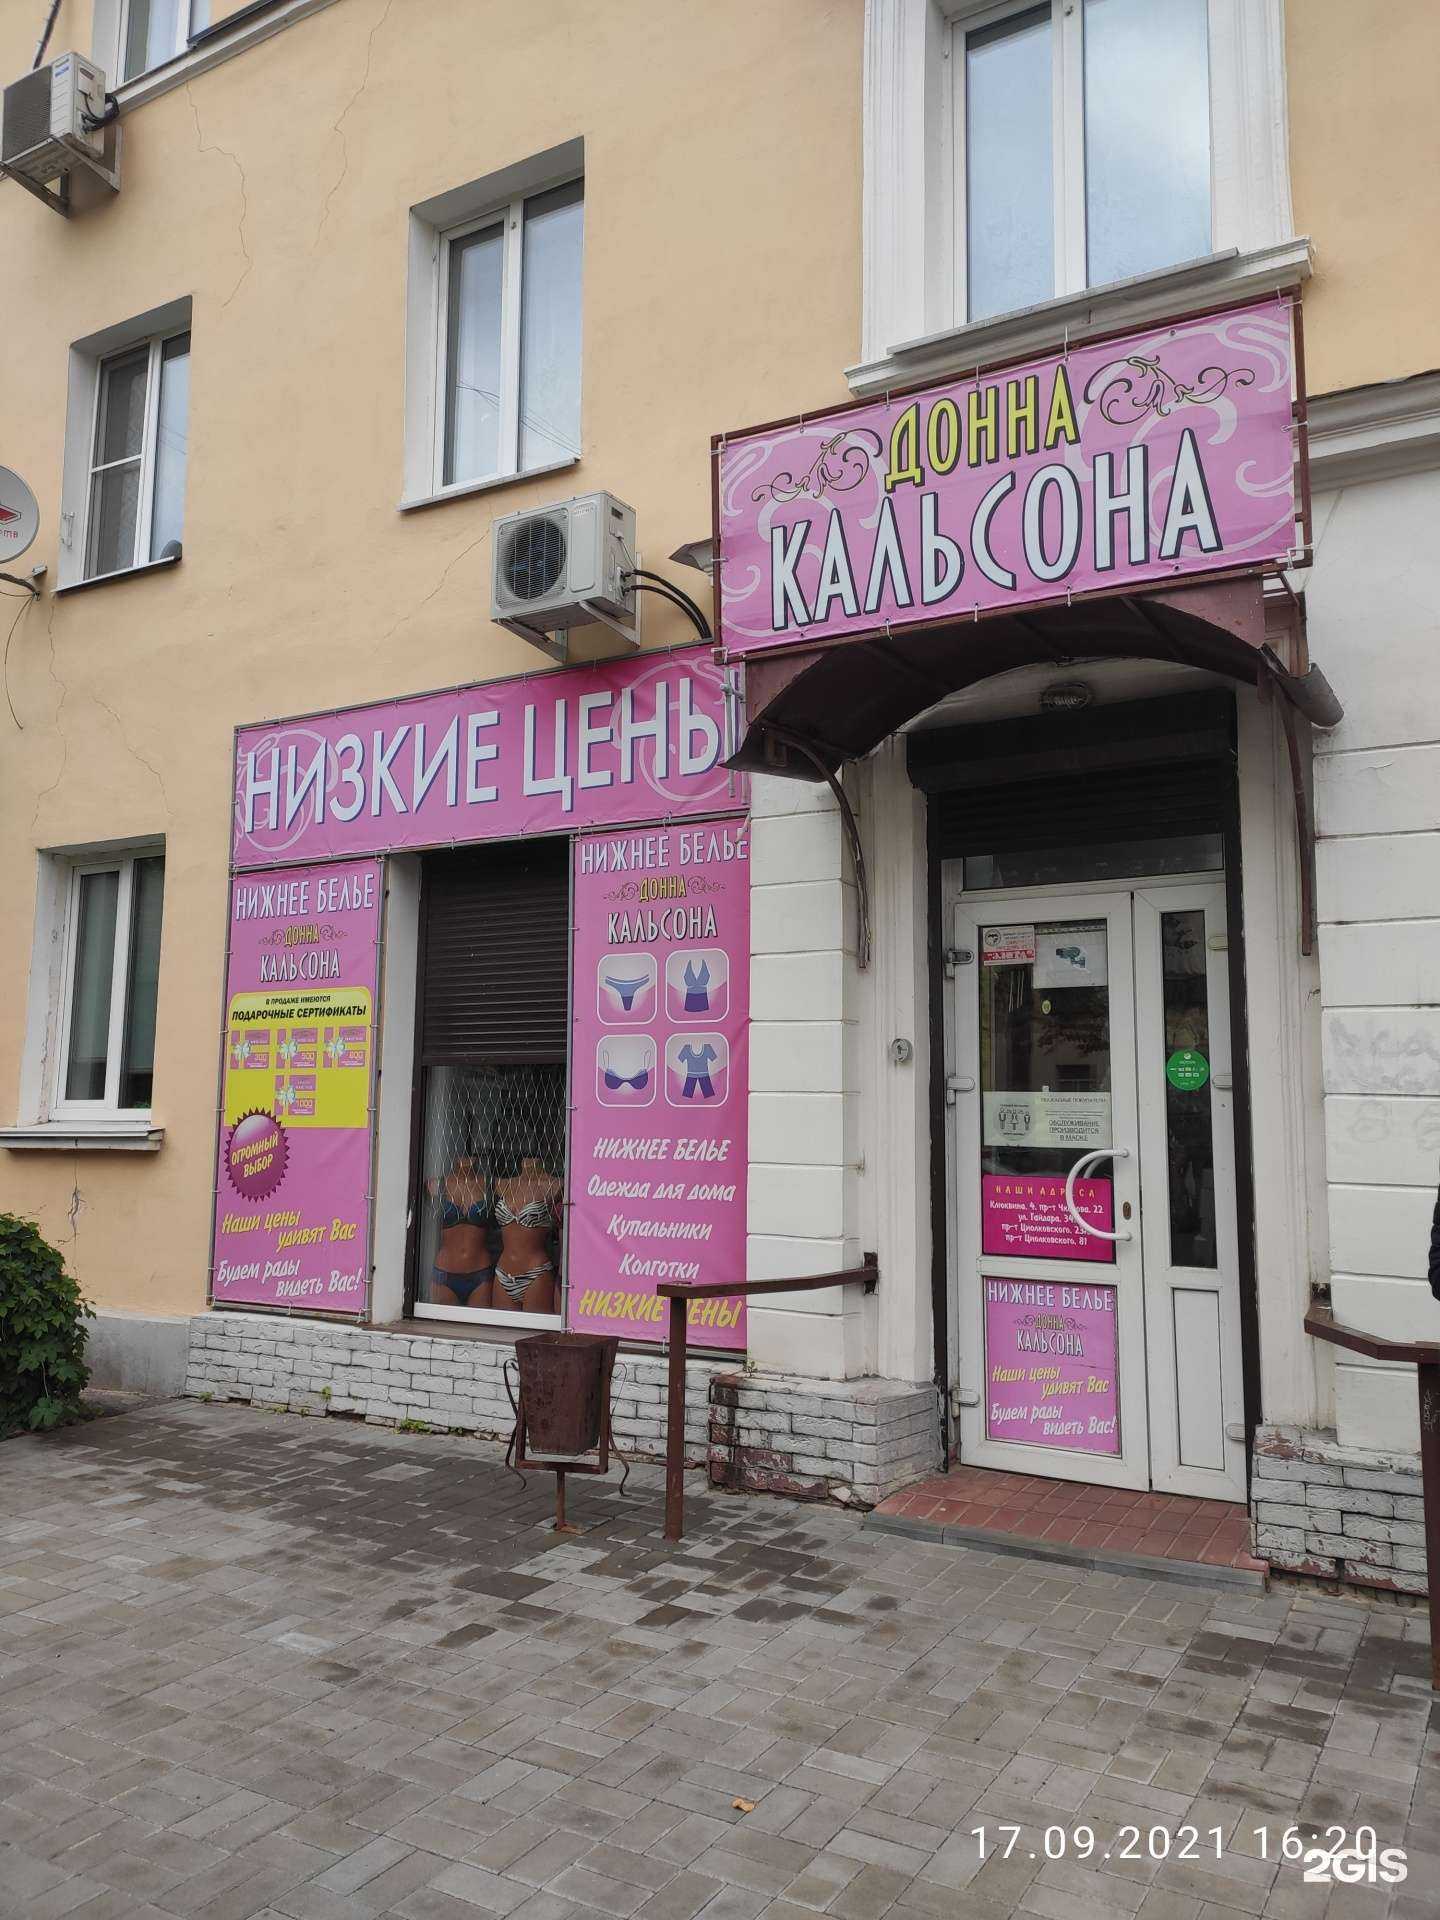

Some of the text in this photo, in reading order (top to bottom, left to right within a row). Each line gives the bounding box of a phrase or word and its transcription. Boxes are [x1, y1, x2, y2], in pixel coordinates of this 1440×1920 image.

[885, 364, 1080, 492] ДОННА
[771, 428, 1224, 631] КАЛЬСОНА
[245, 669, 739, 833] НИЗКИЕ ЦЕНЫ
[580, 827, 749, 875] НИЖНЕЕ БЕЛЬЕ
[235, 873, 374, 921] НИЖНЕЕ БЕЛЬЕ
[639, 874, 687, 903] ДОННА
[284, 923, 321, 948] ДОННА
[607, 904, 719, 945] КАЛЬСОНА
[260, 949, 341, 983] КАЛЬСОНА
[232, 1006, 366, 1022] ПОДАРОЧНЫЕ СЕРТИФИКАТЫ
[271, 997, 299, 1005] ПРОДАЖЕ
[231, 1130, 279, 1167] ОГРОМНЫЙ
[592, 1137, 732, 1163] НИЖНЕЕ БЕЛЬЕ
[243, 1153, 274, 1178] ВЫБОР
[587, 1174, 736, 1203] Одежда для дома
[995, 1185, 1095, 1198] НАШИ АДРСА
[222, 1209, 301, 1234] Наши цены
[276, 1218, 357, 1252] удивят Вас
[606, 1213, 713, 1242] Купальники
[217, 1258, 301, 1290] Будем рады
[618, 1253, 700, 1280] Колготки
[276, 1267, 363, 1298] видеть Вас!
[988, 1281, 1114, 1312] НИЖНЕЕ БЕЛЬЕ
[578, 1288, 743, 1329] НИЗКИЕ ЕНЫ
[1035, 1313, 1065, 1332] ДОННА
[1016, 1328, 1084, 1357] КАЛЬСОНА
[992, 1364, 1061, 1382] Наши цены
[1040, 1375, 1110, 1400] удивят Вас
[991, 1402, 1063, 1425] Будем рады
[1043, 1415, 1117, 1436] видеть Вас!
